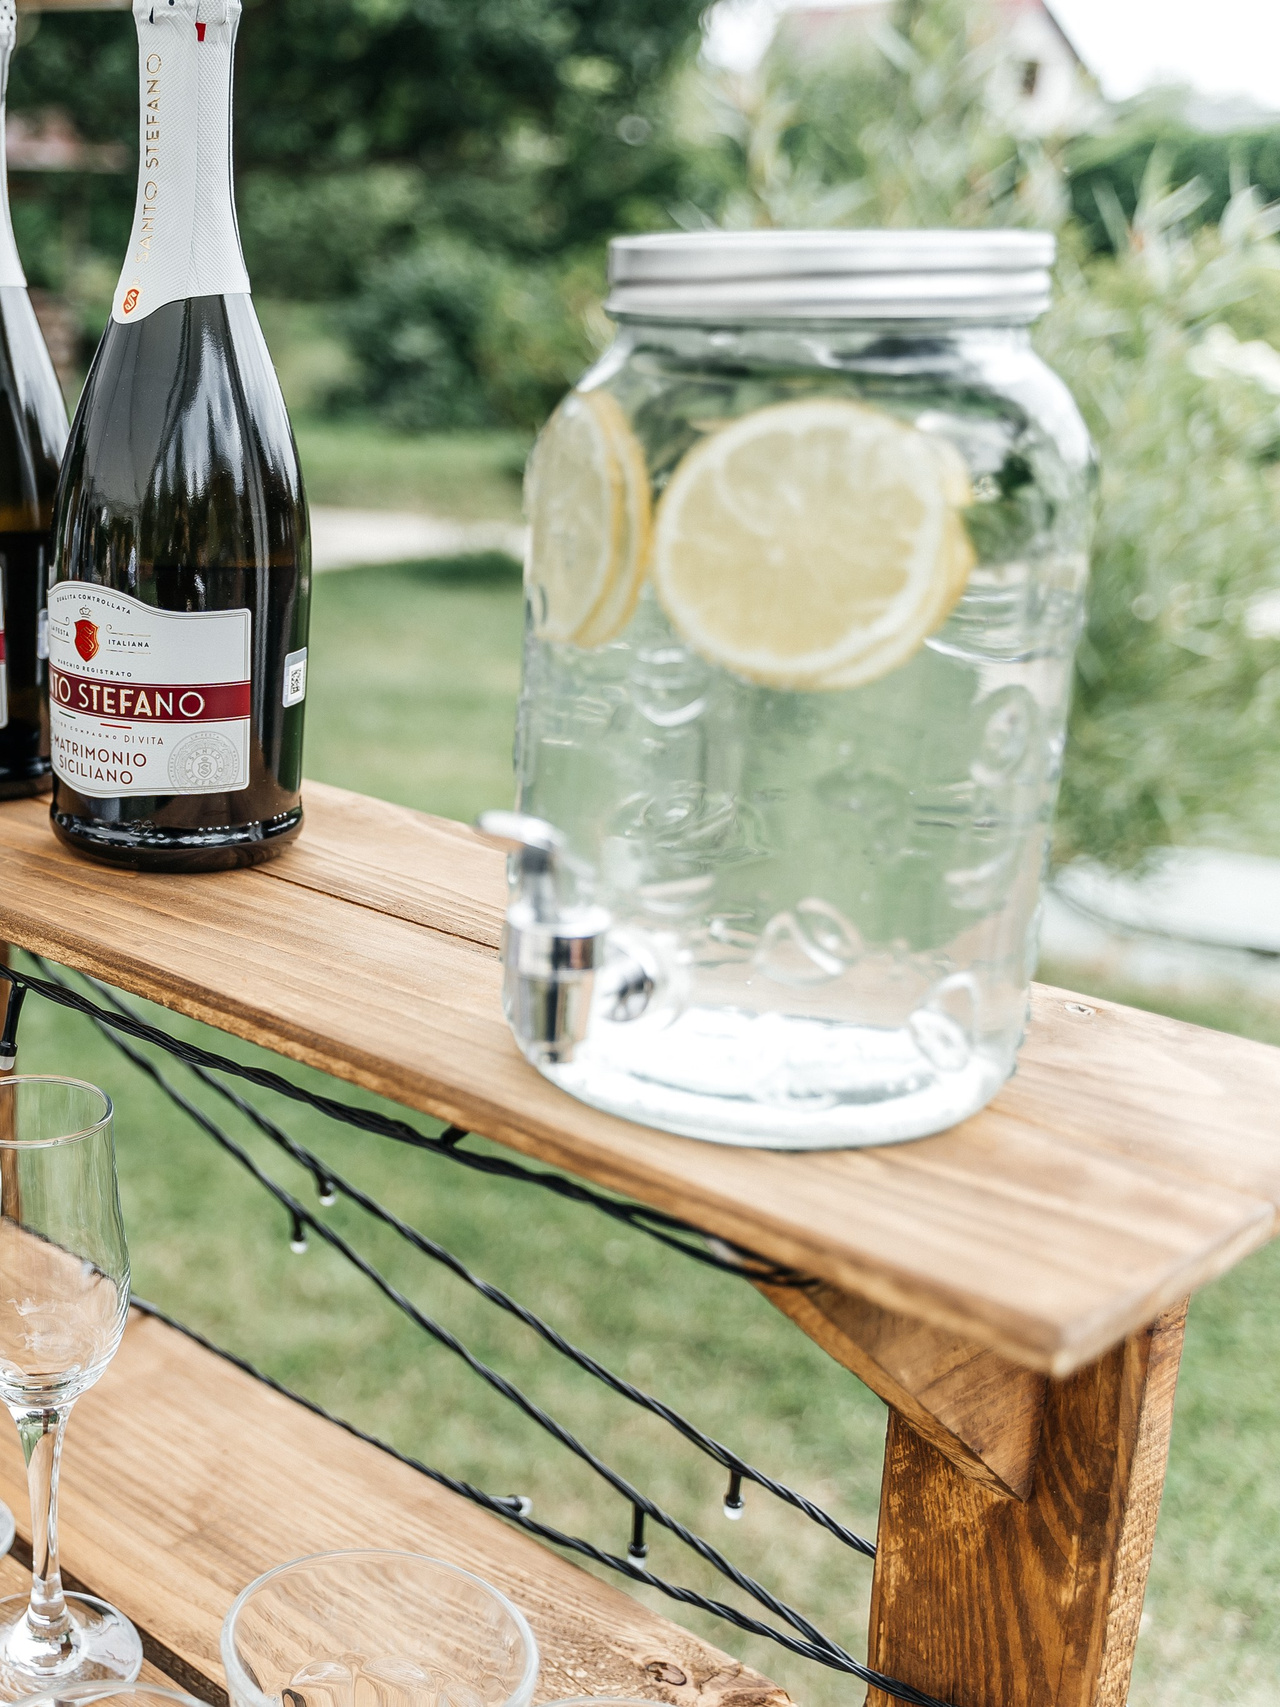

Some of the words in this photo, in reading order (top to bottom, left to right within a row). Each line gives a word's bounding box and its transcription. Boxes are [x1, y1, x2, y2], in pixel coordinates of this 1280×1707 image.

[146, 53, 162, 169] STEFANO
[135, 181, 158, 264] SANTO
[78, 593, 131, 615] CONTROLLATA
[108, 639, 150, 648] ITALIANA
[82, 666, 133, 678] REGISTRATO
[78, 683, 206, 718] STEFANO
[54, 734, 147, 767] MATRIMONIO
[59, 755, 133, 785] SICILIANO
